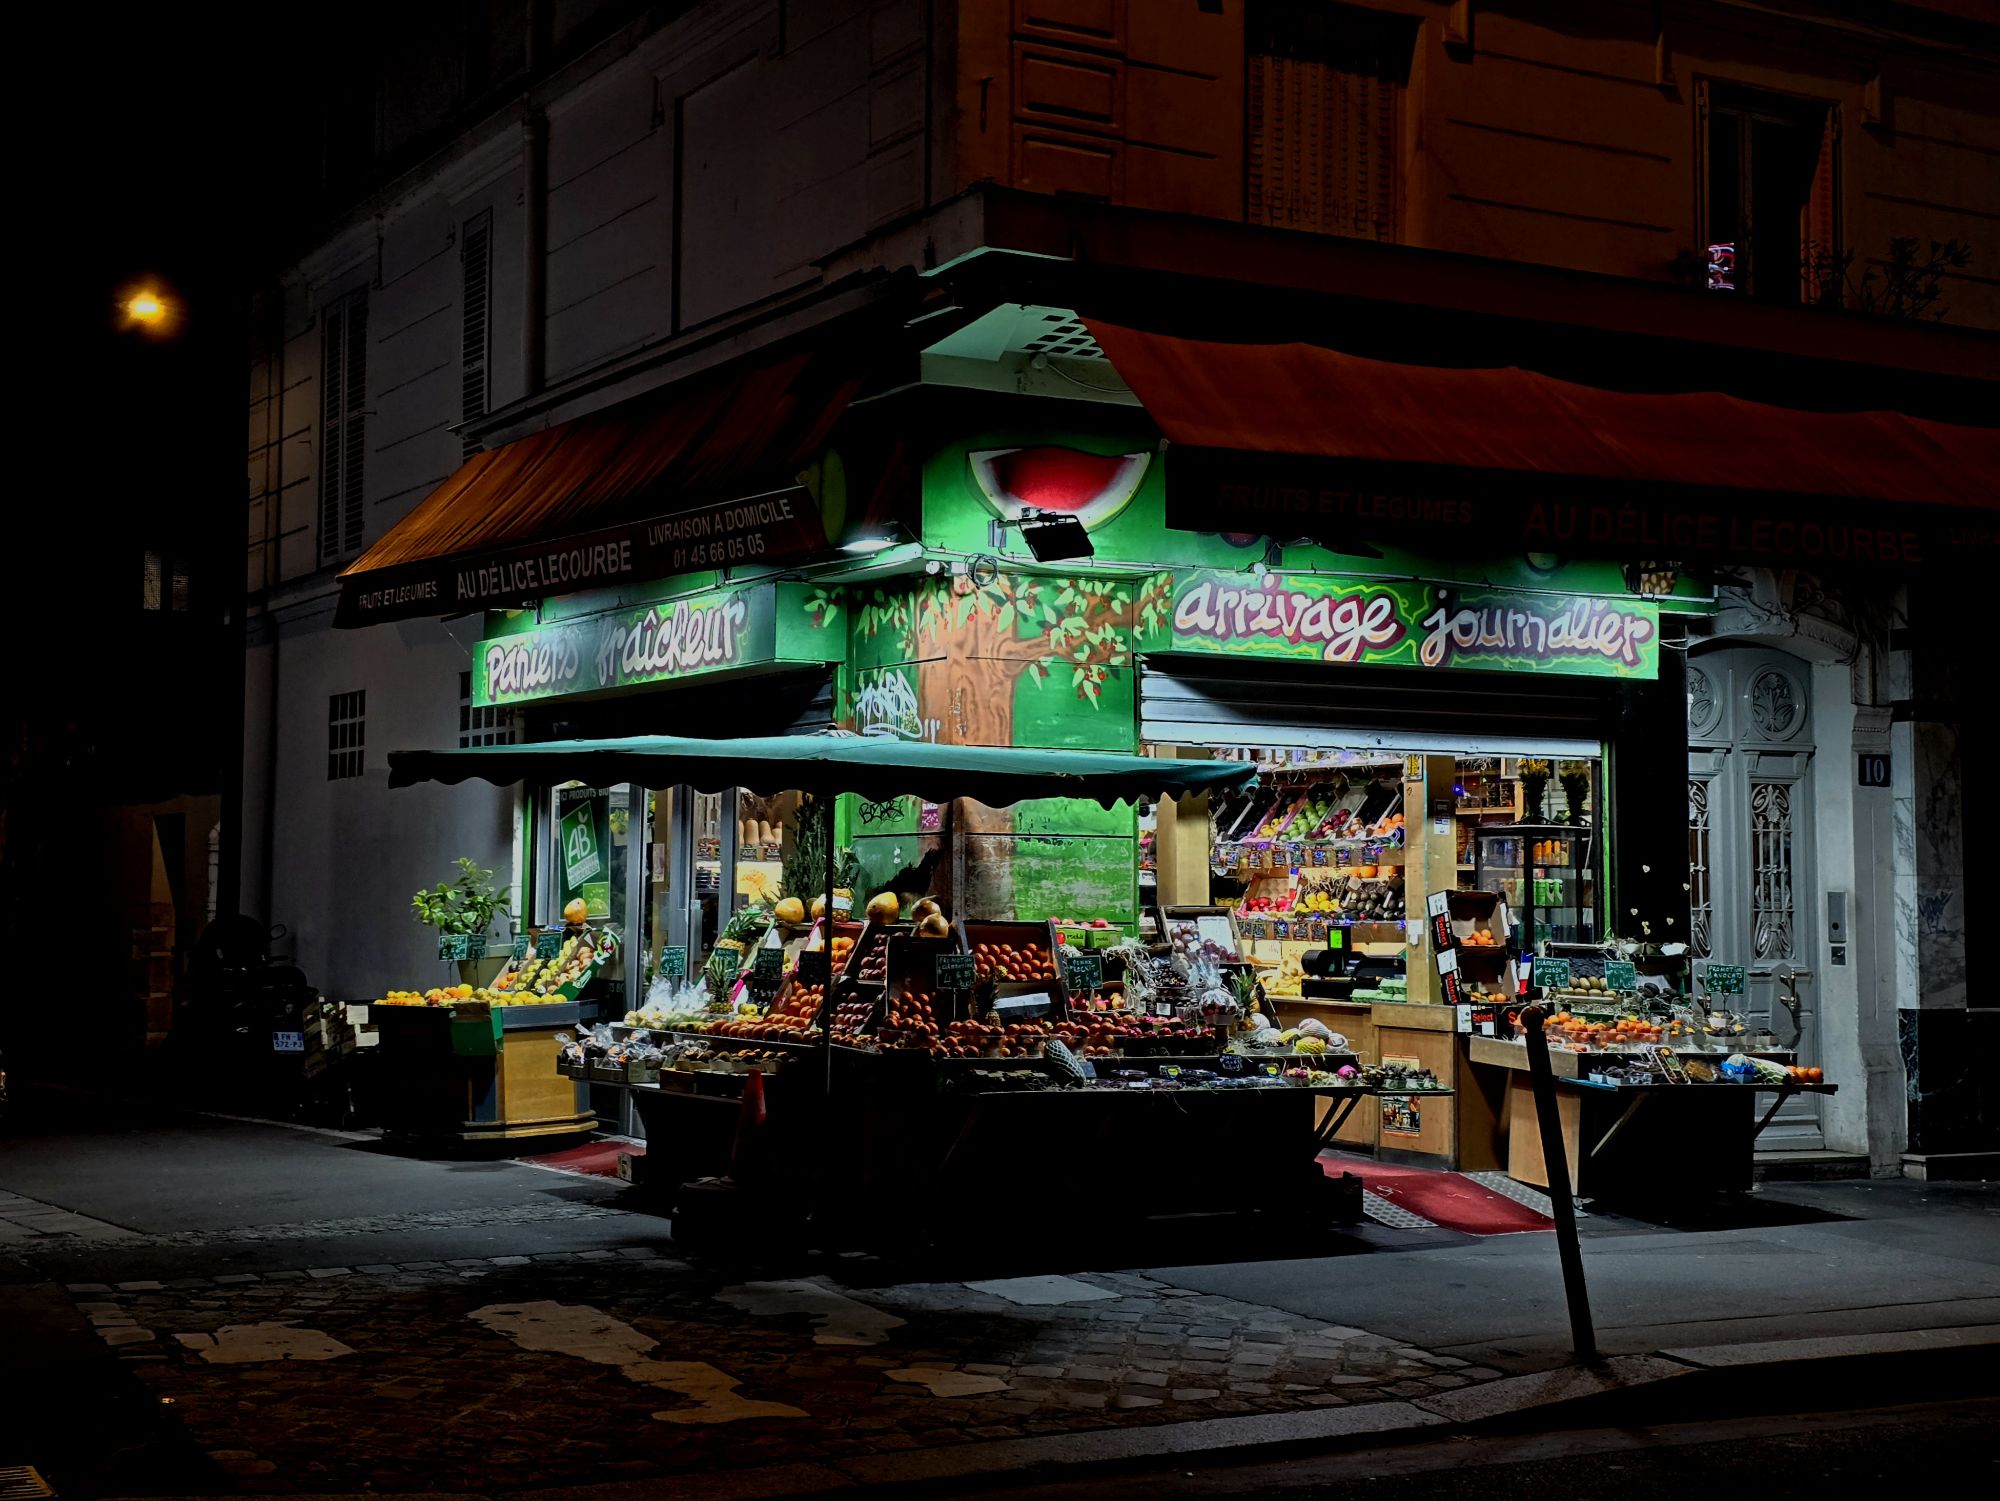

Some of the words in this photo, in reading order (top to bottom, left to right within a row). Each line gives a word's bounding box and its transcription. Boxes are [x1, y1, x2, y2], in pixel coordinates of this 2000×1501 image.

[1218, 485, 1310, 511] FRUITS
[1319, 491, 1350, 513] ET
[648, 515, 711, 547] LIVRAISON
[724, 498, 794, 532] DOMICILE
[1523, 500, 1577, 540] AU
[1589, 500, 1718, 550] DÉLICE
[1729, 510, 1922, 562] LECOURBE
[457, 568, 477, 600] AU
[478, 559, 540, 598] DÉLICE
[539, 540, 632, 586] LECOURBE
[673, 546, 686, 569] 01
[690, 544, 706, 566] 45
[709, 540, 725, 563] 66
[728, 537, 745, 560] 05
[747, 532, 765, 556] 05
[358, 591, 382, 610] FRUITS
[383, 588, 395, 606] ET
[1173, 574, 1404, 662] arrivage
[1421, 588, 1656, 668] journalier
[1864, 757, 1885, 784] 10
[569, 788, 597, 801] PRODUITS
[567, 822, 592, 867] AB
